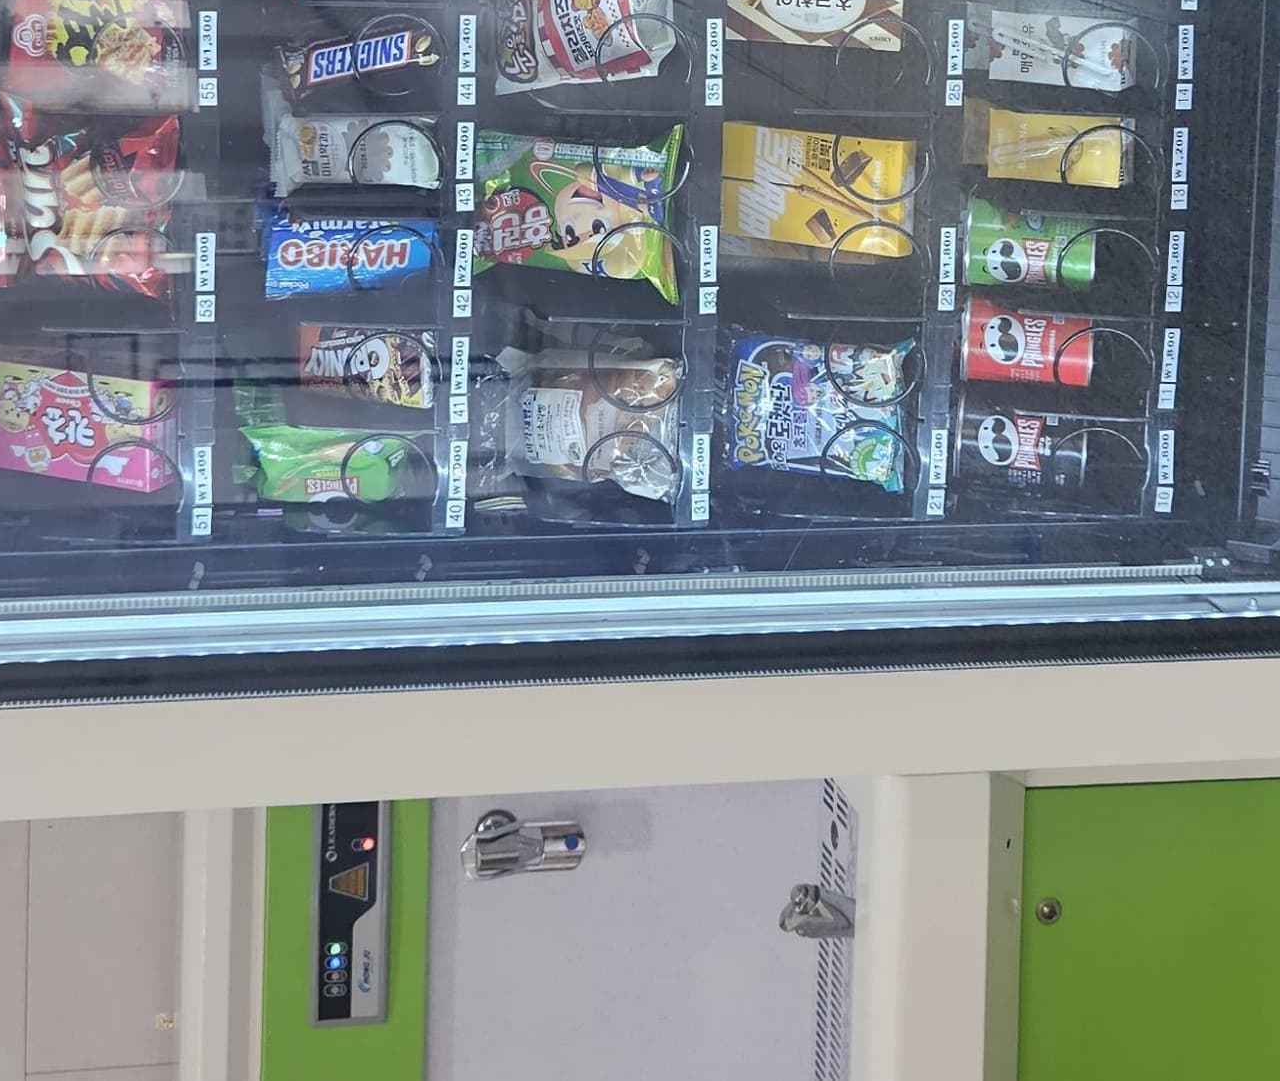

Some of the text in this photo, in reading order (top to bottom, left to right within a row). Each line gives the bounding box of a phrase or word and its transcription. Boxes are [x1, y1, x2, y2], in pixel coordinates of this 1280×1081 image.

[311, 34, 410, 81] SNICKERS
[460, 83, 474, 100] 44
[707, 83, 720, 101] 35
[948, 84, 961, 101] 25
[738, 127, 795, 241] 빼빼로
[278, 239, 412, 269] HARIBO
[1024, 240, 1050, 283] PRINGLES
[198, 299, 214, 317] 53
[455, 295, 469, 312] 42
[1167, 290, 1181, 307] 12
[303, 338, 390, 380] CRUNKY
[1023, 317, 1047, 367] PRINGLES
[41, 405, 96, 447] 칸쵸
[767, 383, 792, 439] 로켓단
[1017, 417, 1042, 469] PRINGLES
[693, 499, 706, 515] 31
